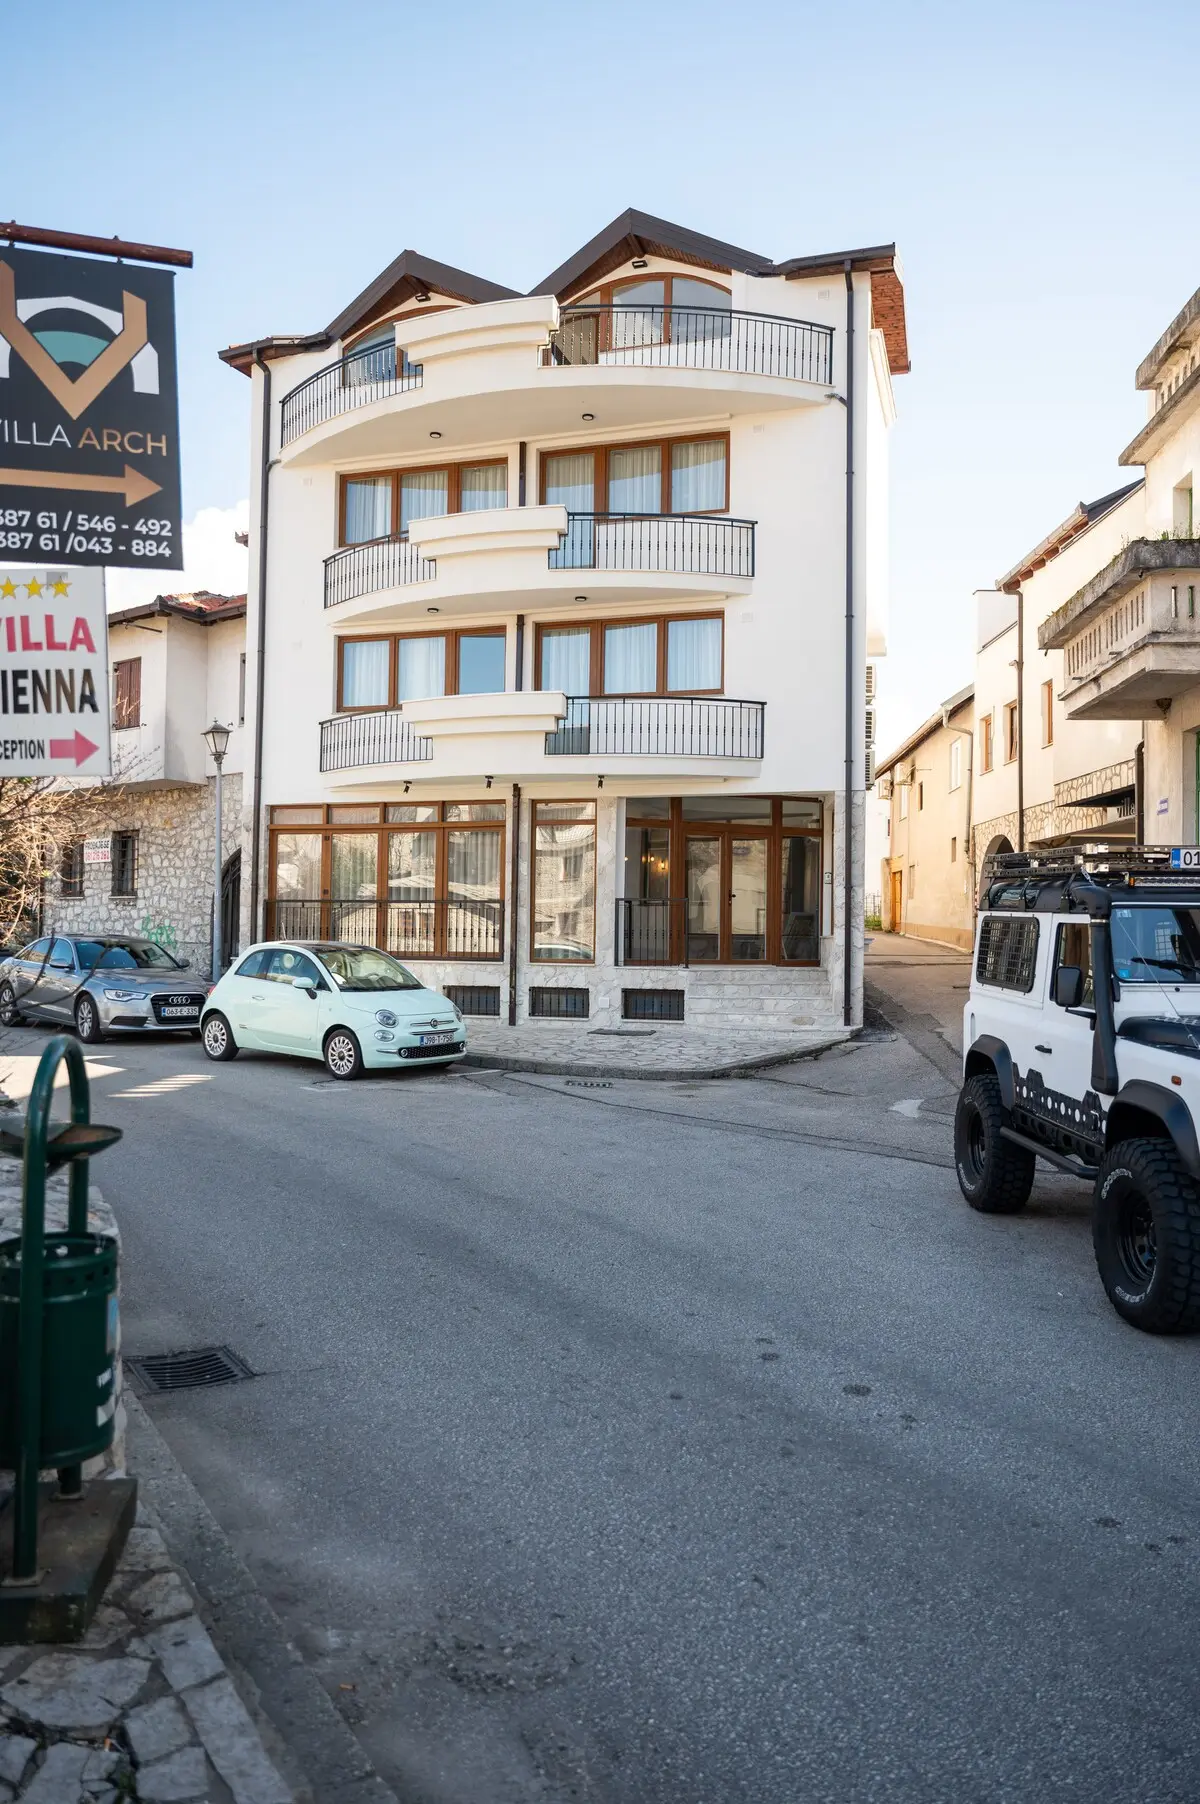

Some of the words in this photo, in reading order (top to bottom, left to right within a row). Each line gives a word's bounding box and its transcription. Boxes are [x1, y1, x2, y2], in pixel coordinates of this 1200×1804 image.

[0, 419, 72, 448] ILLA
[77, 427, 168, 457] ARCH
[37, 511, 57, 529] 61
[76, 514, 117, 533] 546
[134, 518, 172, 537] 492
[39, 533, 60, 551] 61
[131, 539, 172, 557] 884
[0, 614, 97, 653] ILLA
[1183, 851, 1200, 866] 01
